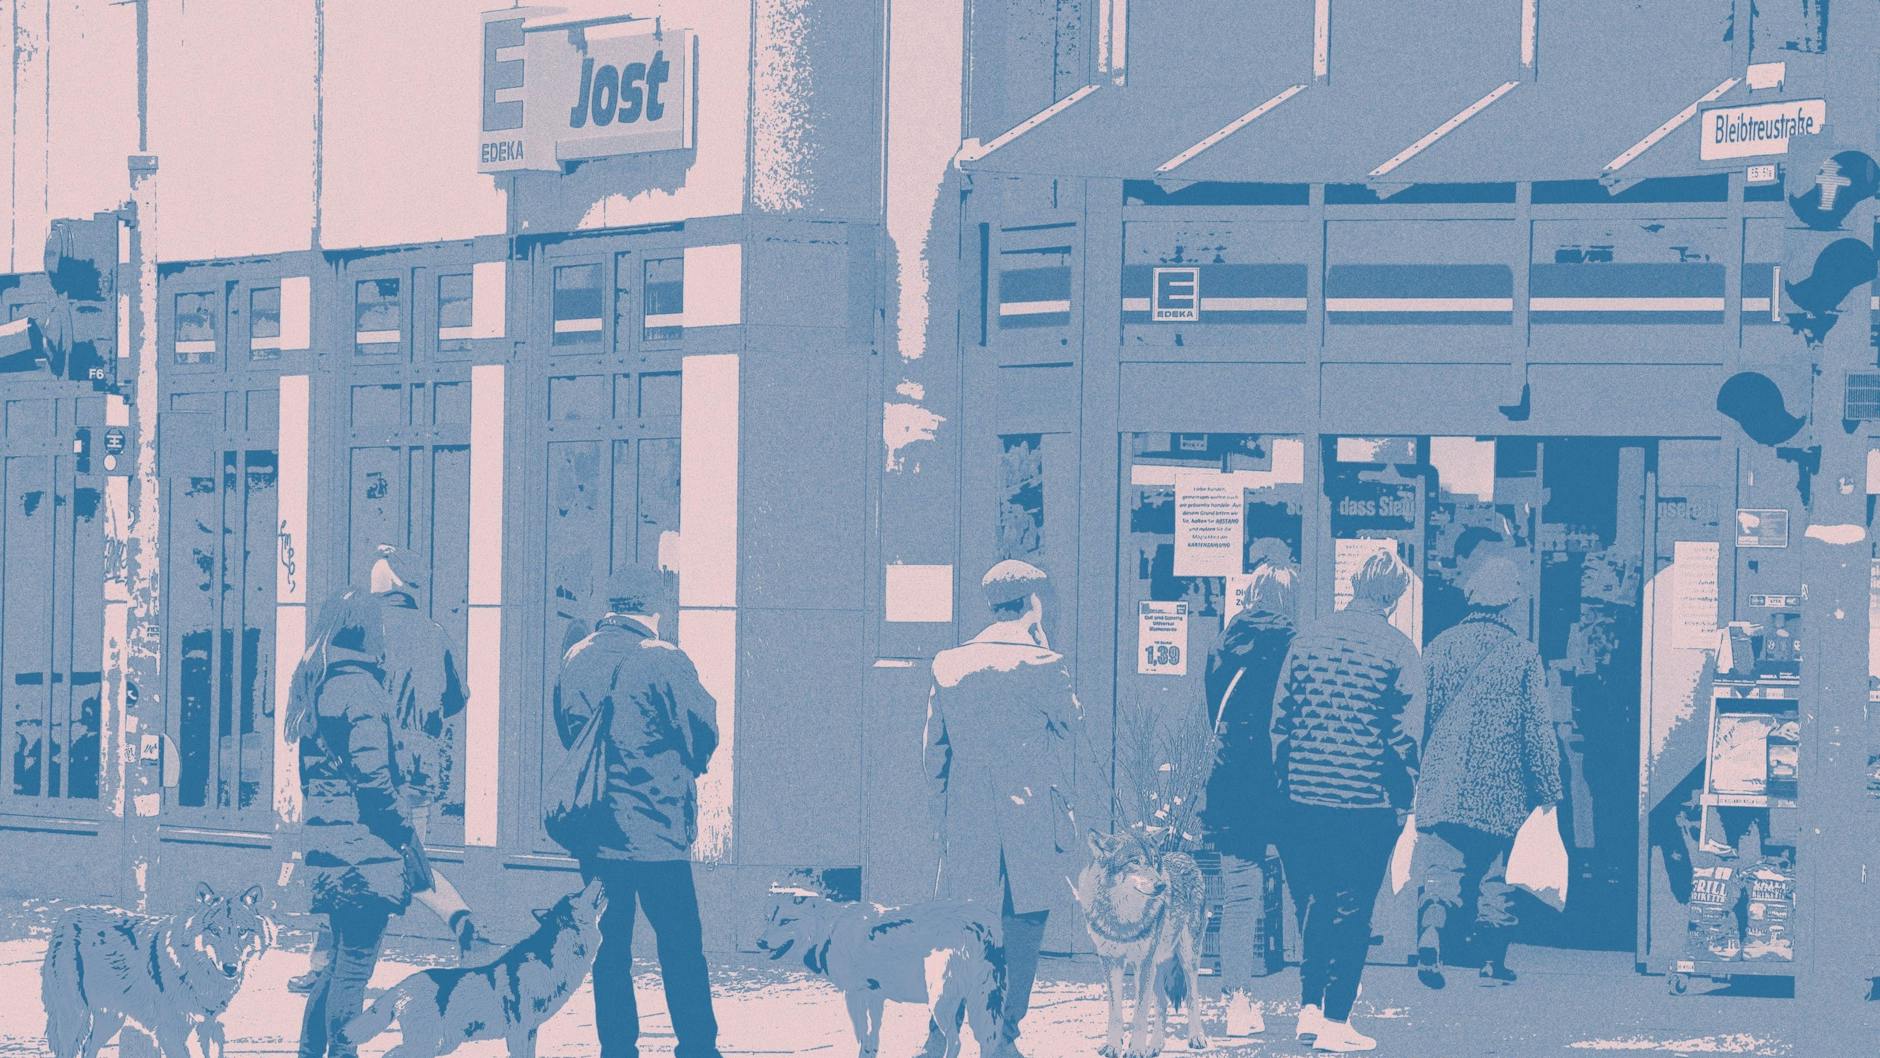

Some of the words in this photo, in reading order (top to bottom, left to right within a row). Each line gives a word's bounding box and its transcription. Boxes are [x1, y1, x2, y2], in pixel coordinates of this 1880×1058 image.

[569, 50, 670, 129] Jost
[1715, 107, 1814, 145] Bleibtreustraße
[481, 140, 524, 163] EDEKA
[1157, 310, 1194, 318] EDEKA
[89, 369, 104, 379] F6
[1340, 496, 1376, 516] dass
[1145, 645, 1180, 666] 1,39
